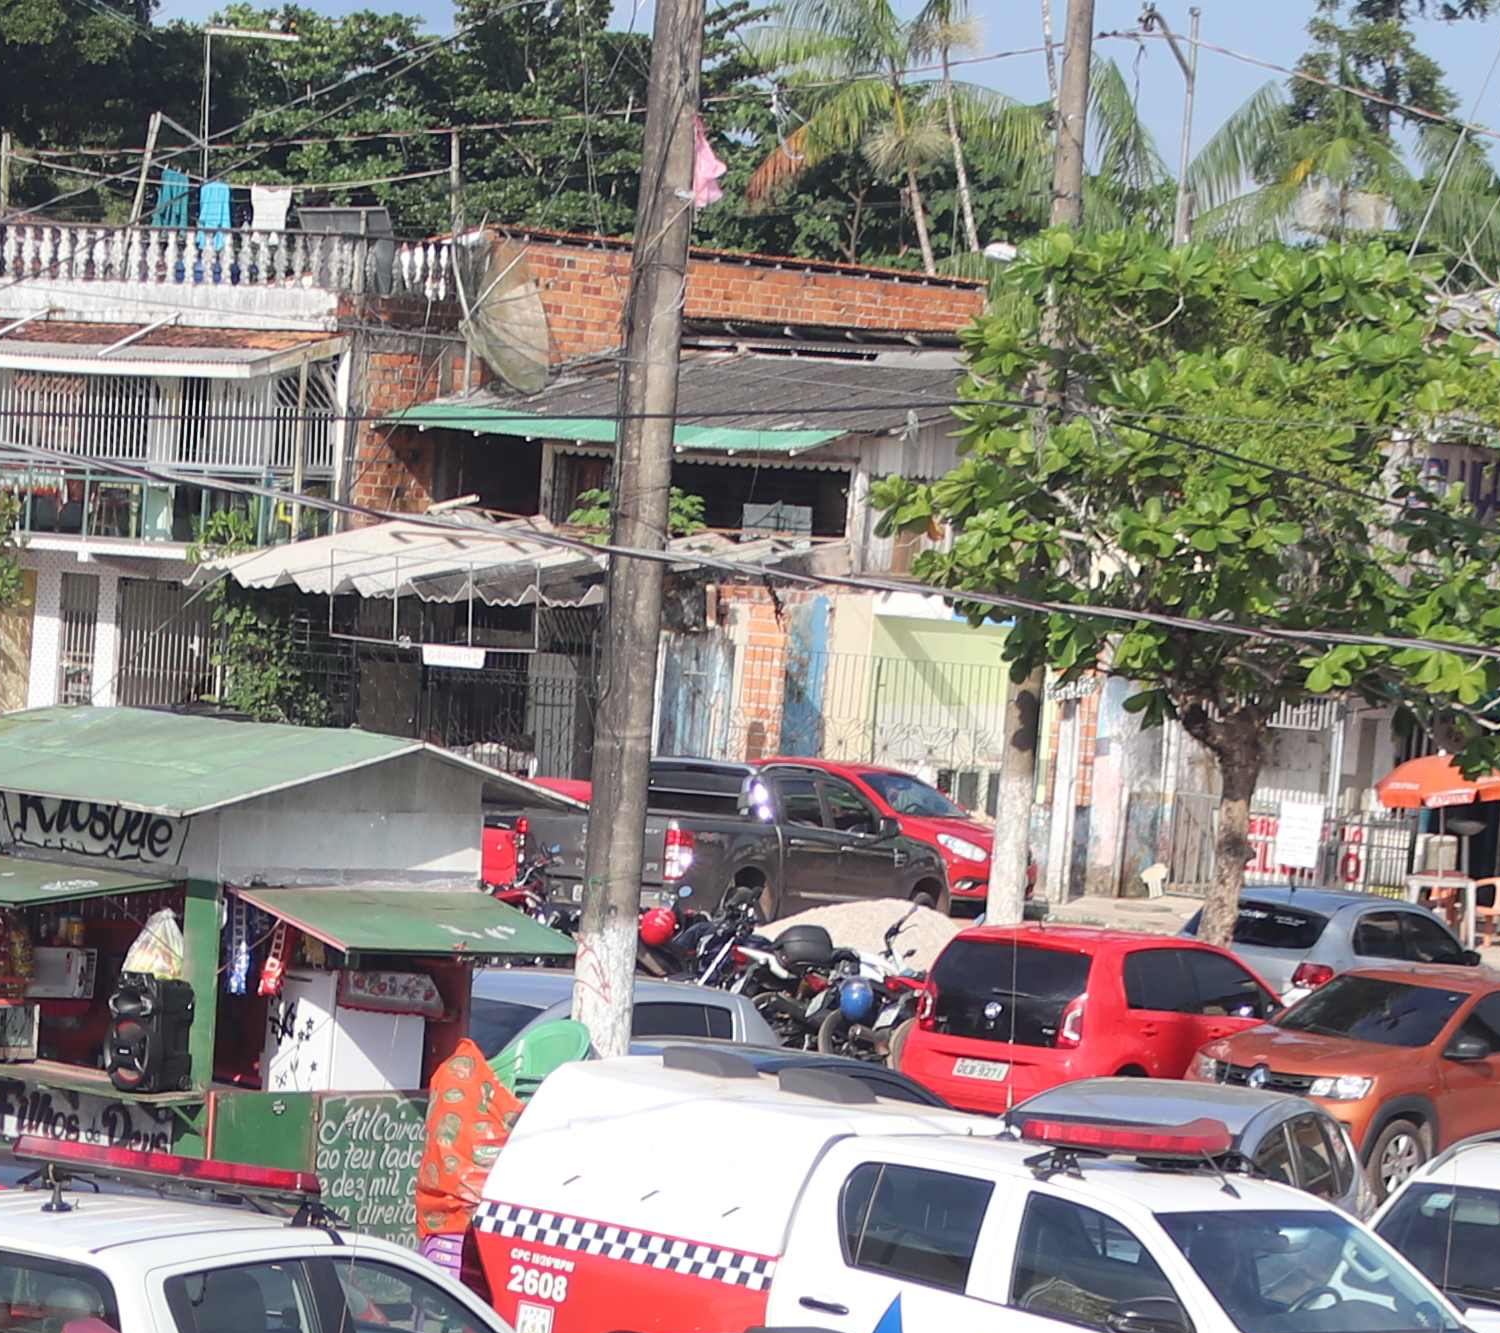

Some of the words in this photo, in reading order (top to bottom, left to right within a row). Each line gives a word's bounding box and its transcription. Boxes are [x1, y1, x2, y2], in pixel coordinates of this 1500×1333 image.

[316, 1149, 341, 1171] ao
[344, 1142, 376, 1171] teu
[368, 1170, 400, 1197] mil
[510, 1247, 532, 1262] CPC
[506, 1264, 569, 1303] 2608
